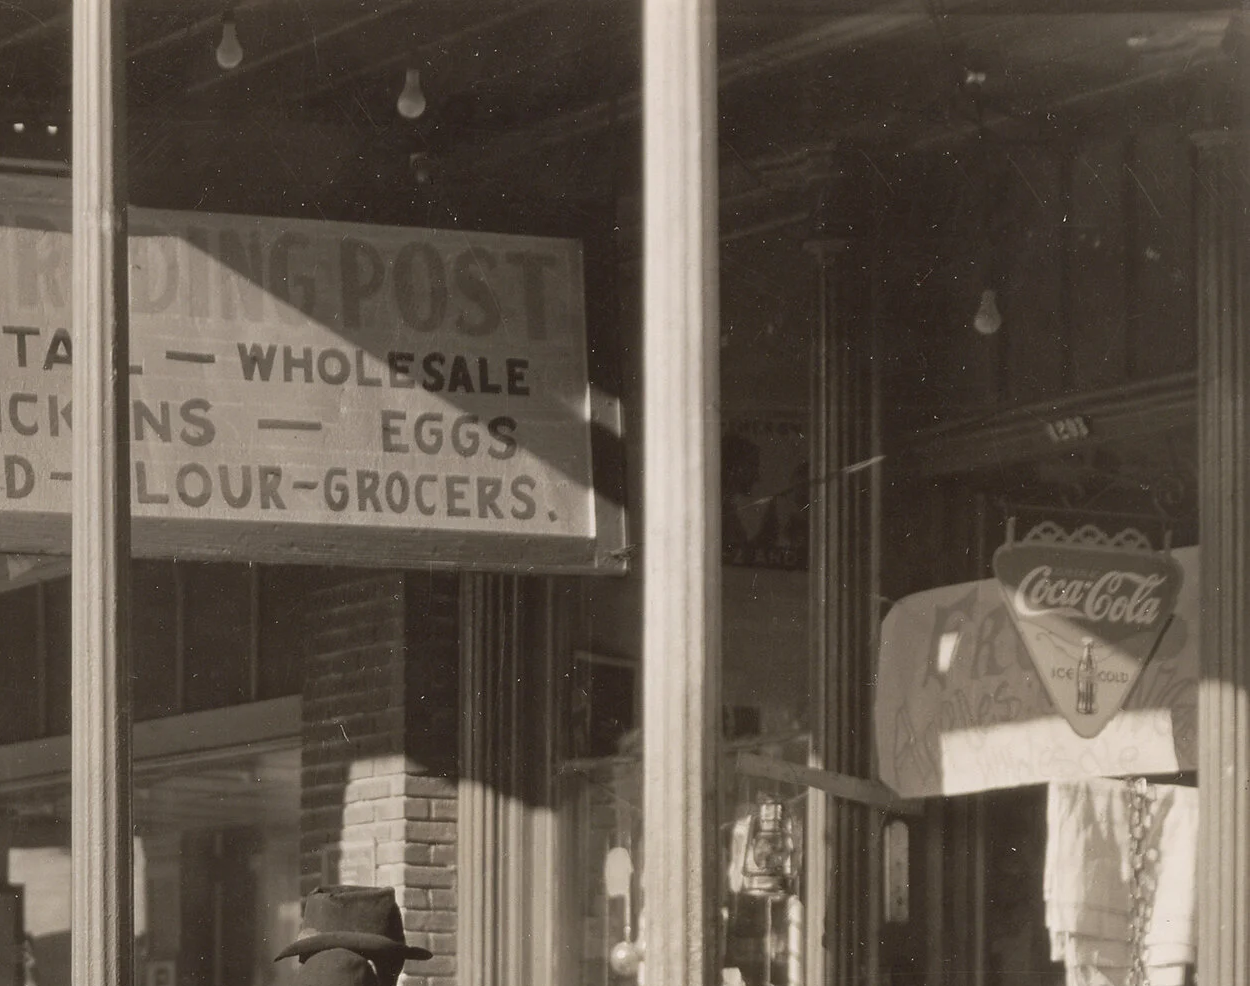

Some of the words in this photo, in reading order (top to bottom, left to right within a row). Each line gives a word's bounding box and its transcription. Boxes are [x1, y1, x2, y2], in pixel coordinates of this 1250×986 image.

[339, 238, 561, 342] POST
[238, 341, 531, 398] WHOLESALE
[380, 408, 518, 459] EGGS
[1014, 565, 1169, 626] Coca-Cola
[1051, 667, 1075, 680] ICE
[1098, 670, 1130, 684] COLD
